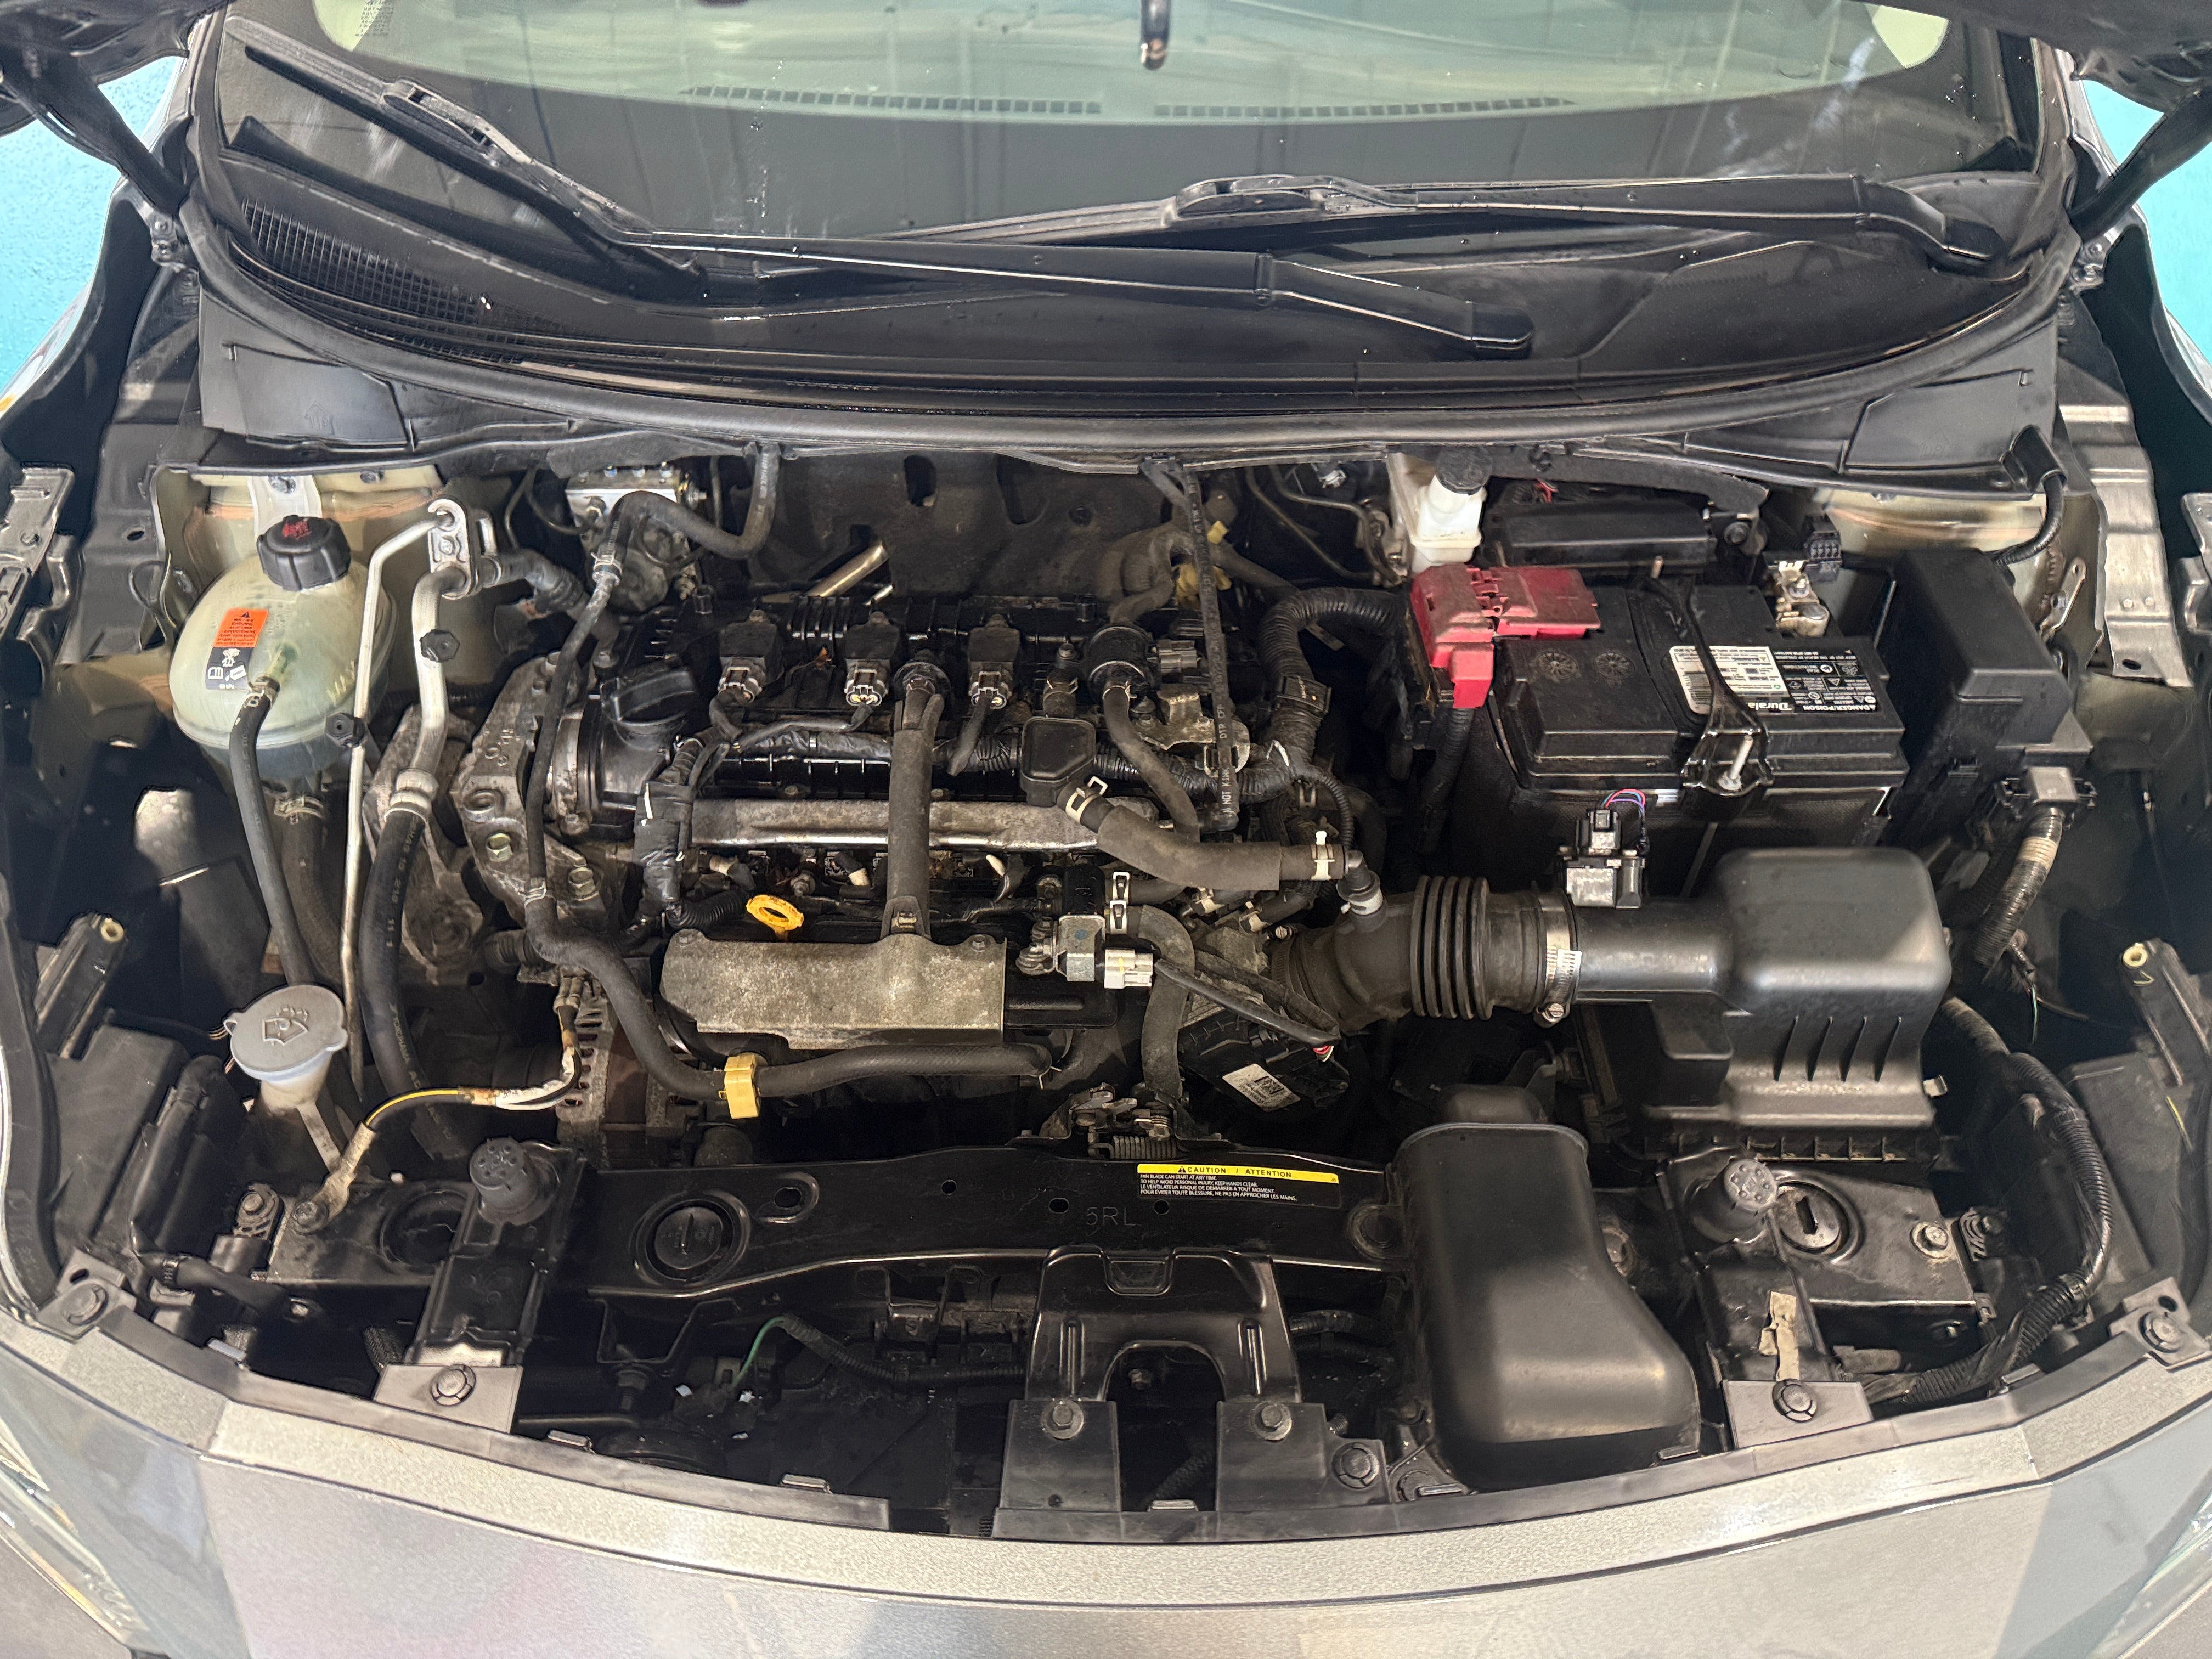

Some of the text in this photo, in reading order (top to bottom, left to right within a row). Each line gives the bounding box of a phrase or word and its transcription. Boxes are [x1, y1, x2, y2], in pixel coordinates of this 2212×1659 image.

[1748, 702, 1792, 711] Durala
[1222, 791, 1231, 805] NOT
[1245, 1168, 1291, 1178] ATTENTION
[1086, 1206, 1136, 1226] 5RL
